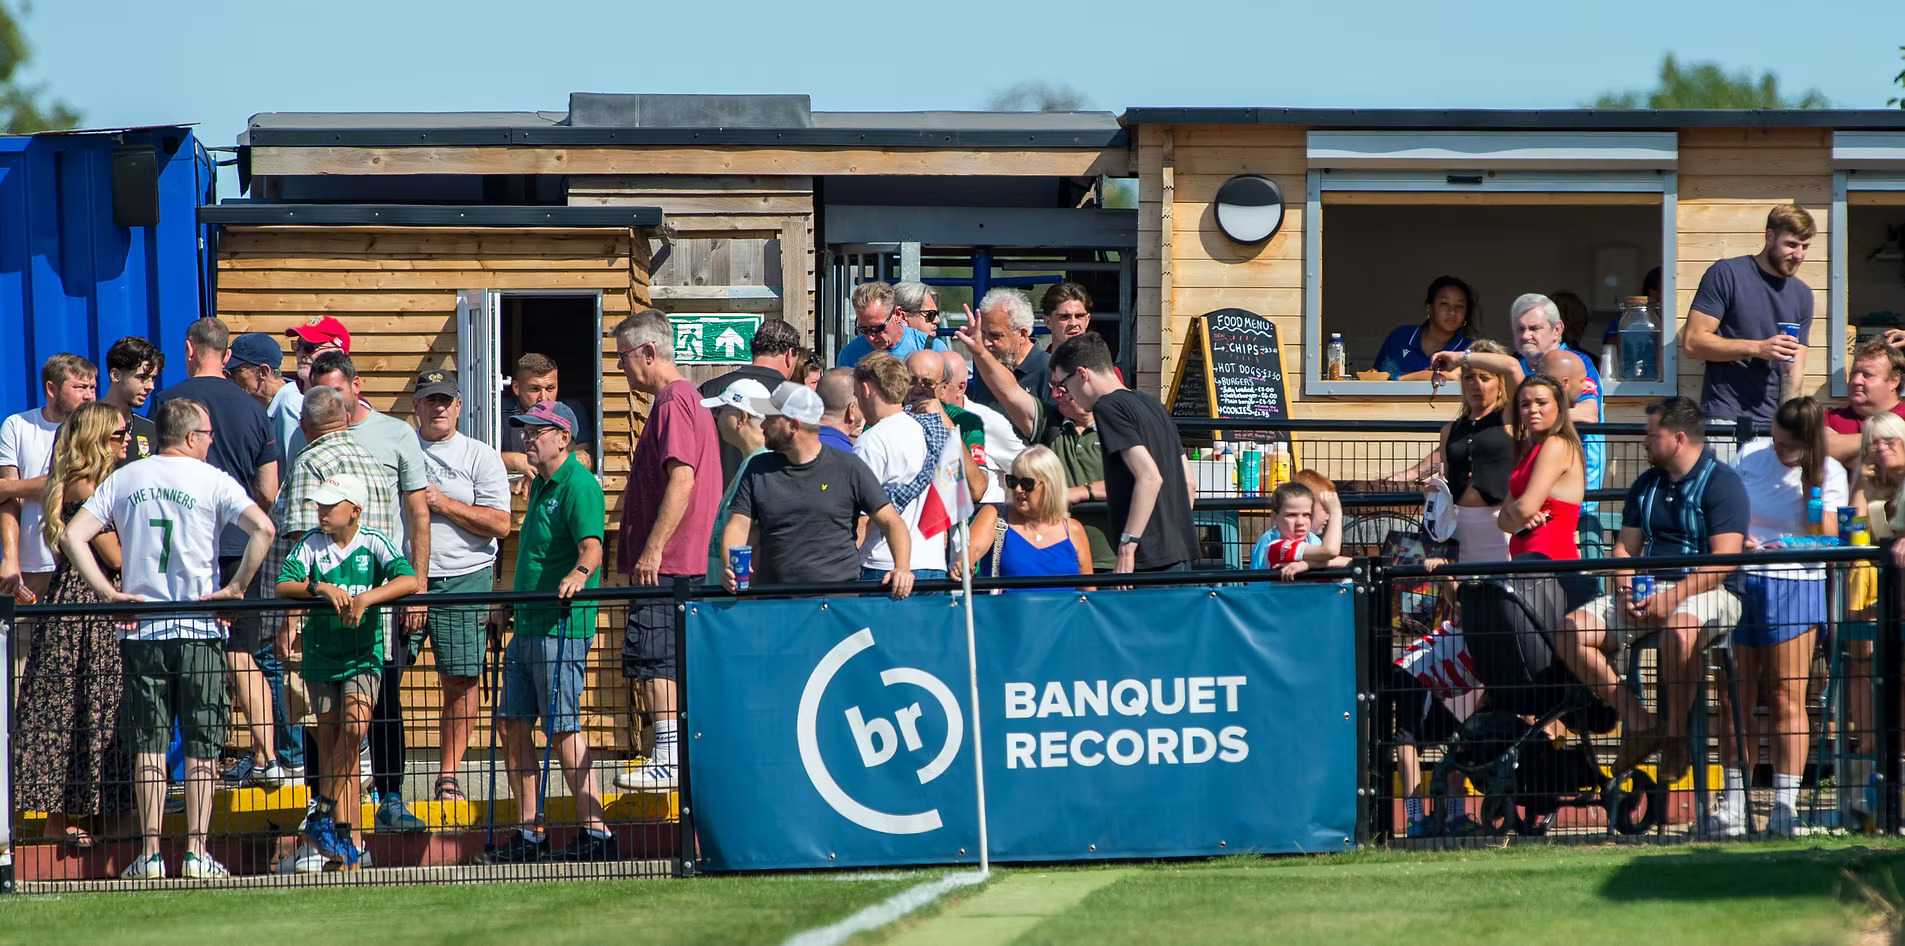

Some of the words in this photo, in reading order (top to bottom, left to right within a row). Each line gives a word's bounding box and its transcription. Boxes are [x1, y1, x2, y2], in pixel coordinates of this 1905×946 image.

[1217, 315, 1243, 328] FOOD
[1229, 342, 1259, 356] CHIPS
[1217, 362, 1236, 374] HOT
[1239, 364, 1261, 378] DOGS
[1221, 376, 1255, 387] BURGERS
[1222, 405, 1253, 416] COOKIES
[127, 488, 148, 507] THE
[149, 487, 197, 510] TANNERS
[149, 518, 174, 574] 7
[1004, 675, 1248, 718] BANQUET
[1006, 726, 1250, 769] RECORDS
